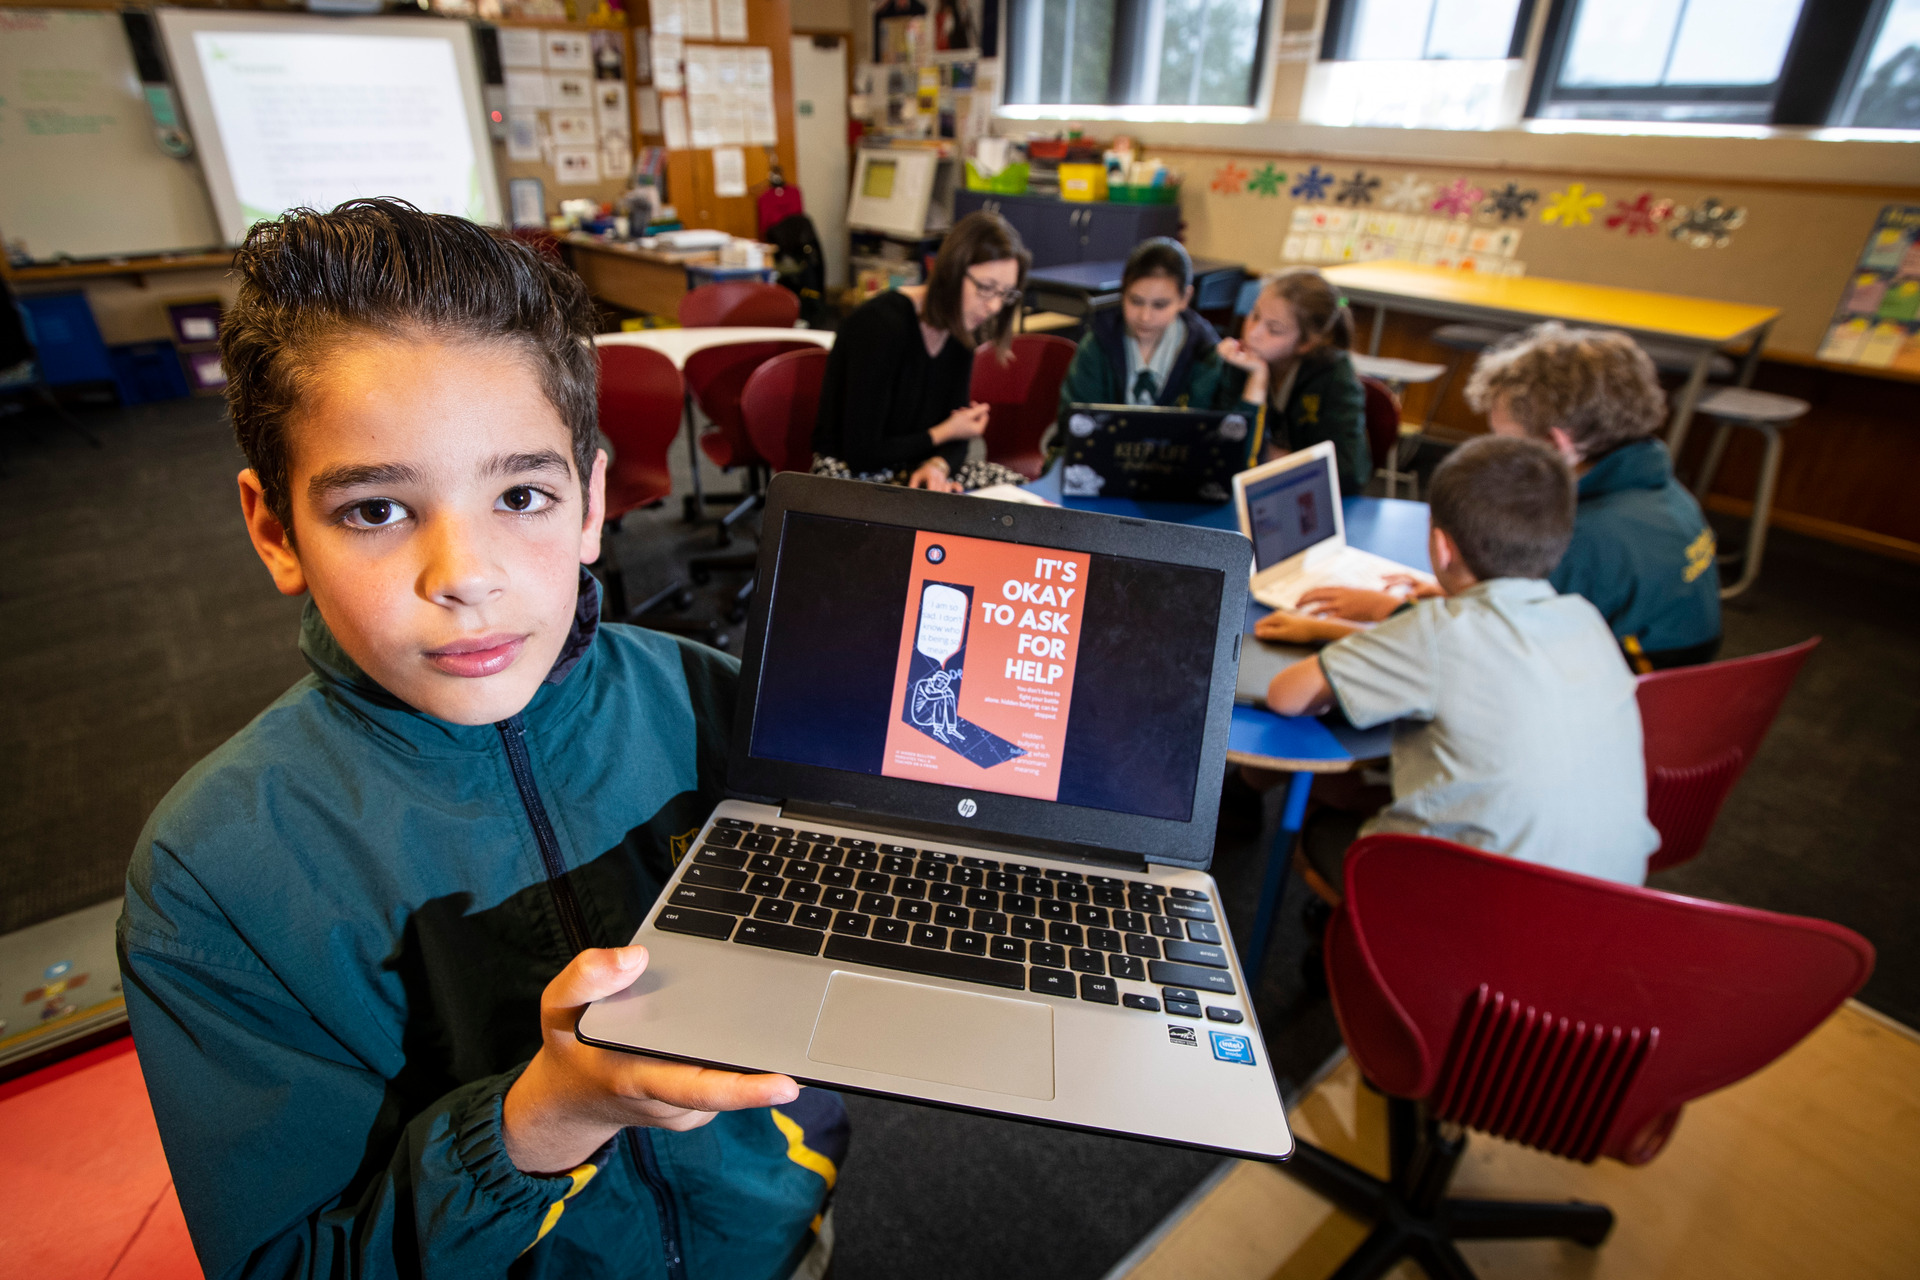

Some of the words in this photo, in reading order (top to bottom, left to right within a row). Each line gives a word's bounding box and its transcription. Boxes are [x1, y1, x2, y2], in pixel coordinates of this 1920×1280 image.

[1034, 558, 1078, 582] IT'S
[1002, 580, 1076, 608] OKAY
[923, 623, 942, 632] know
[982, 602, 1014, 626] TO
[1018, 608, 1070, 634] ASK
[1018, 634, 1066, 660] FOR
[1004, 658, 1063, 685] HELP
[960, 799, 975, 817] hp
[1222, 1040, 1240, 1049] intel
